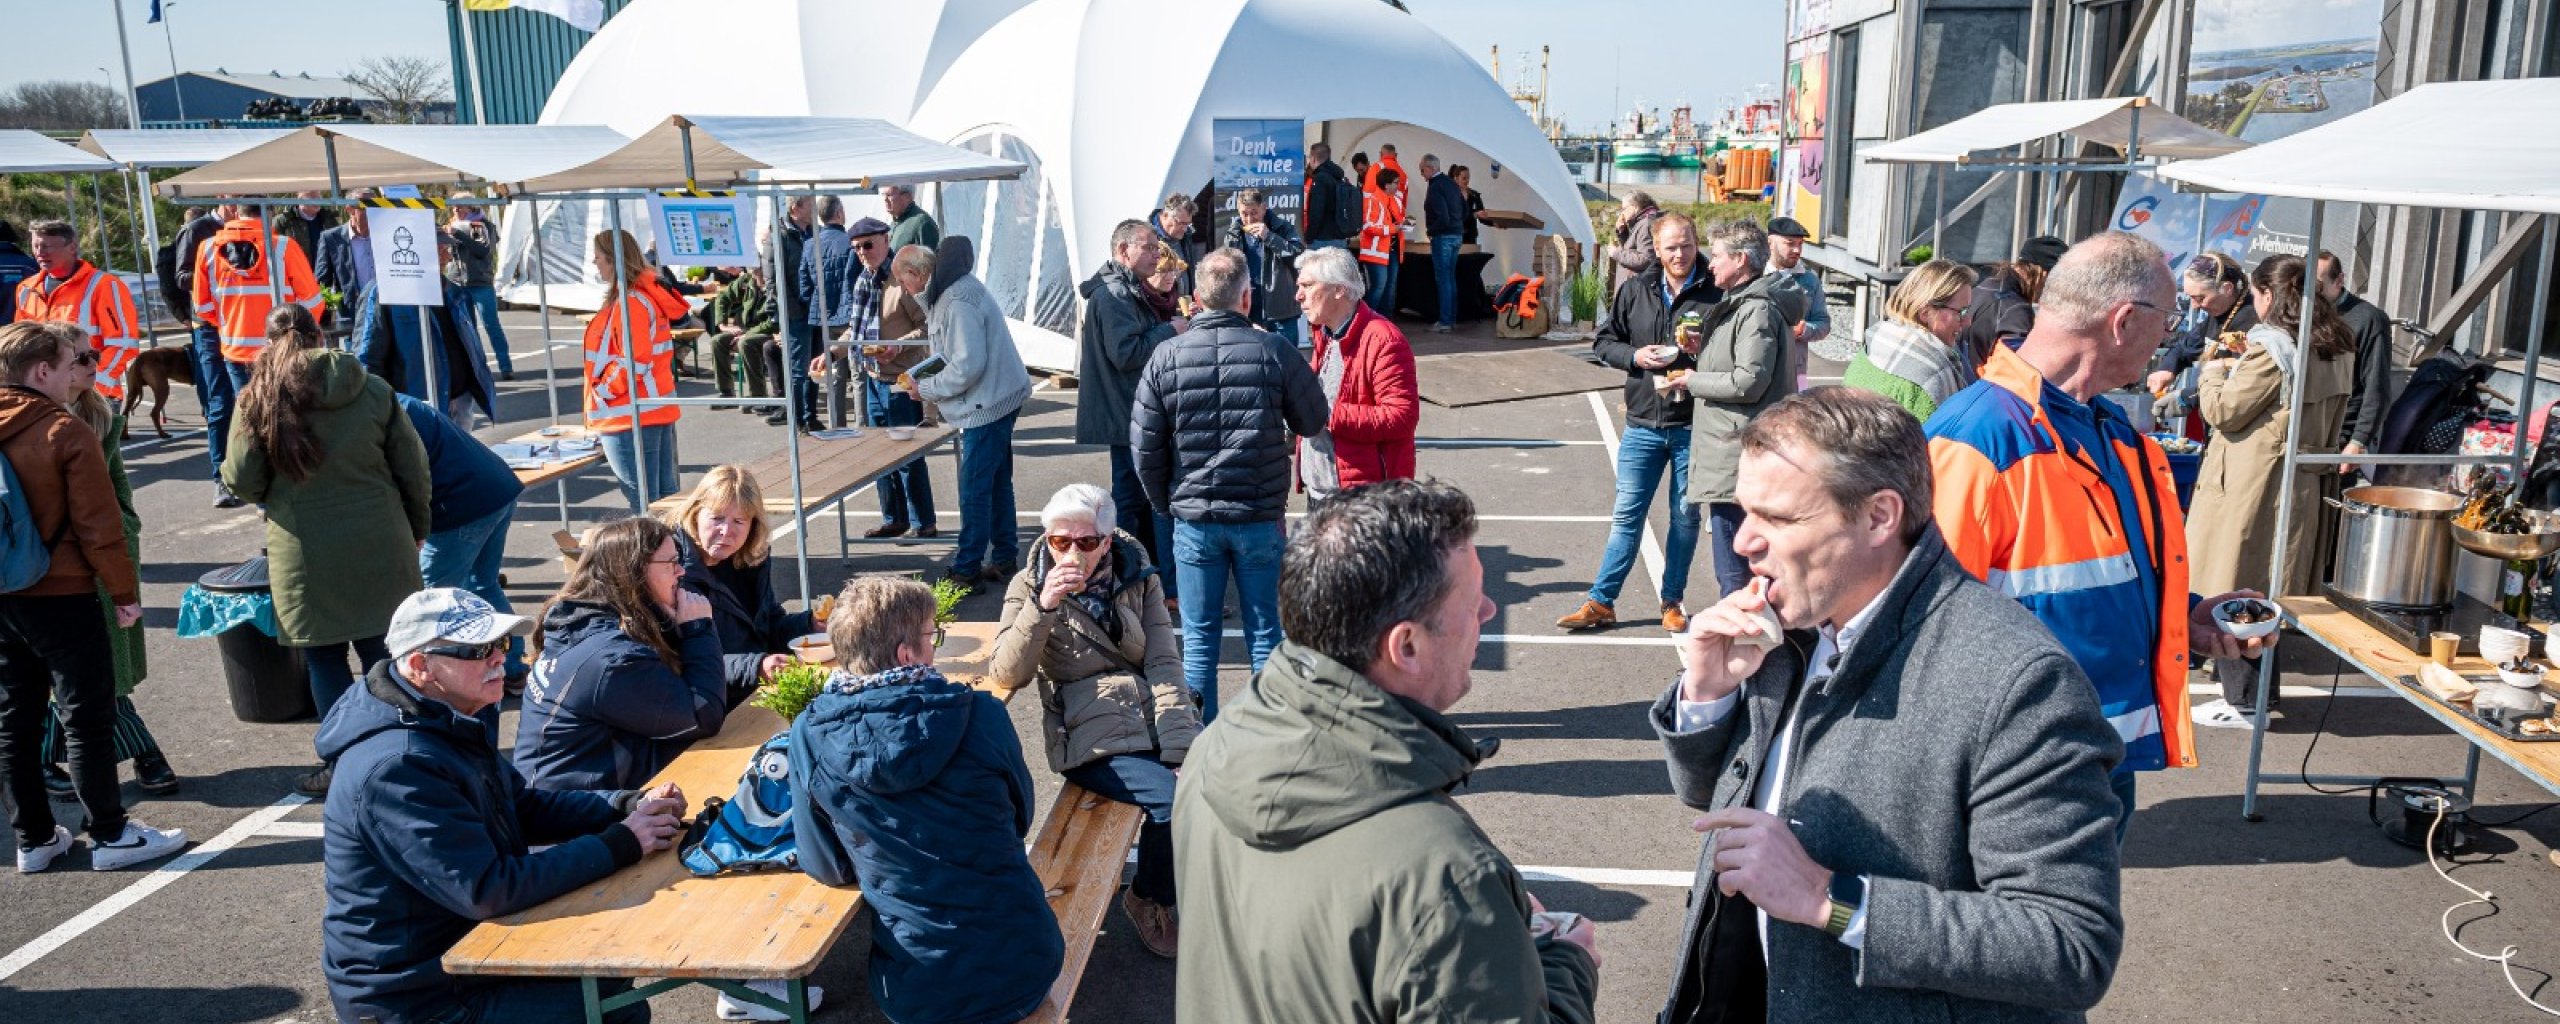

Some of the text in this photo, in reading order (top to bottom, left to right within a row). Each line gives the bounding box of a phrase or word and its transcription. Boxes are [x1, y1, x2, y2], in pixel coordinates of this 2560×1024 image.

[1231, 136, 1276, 156] Denk
[1258, 159, 1293, 173] mee
[1238, 177, 1288, 187] over onze
[1268, 194, 1299, 209] van
